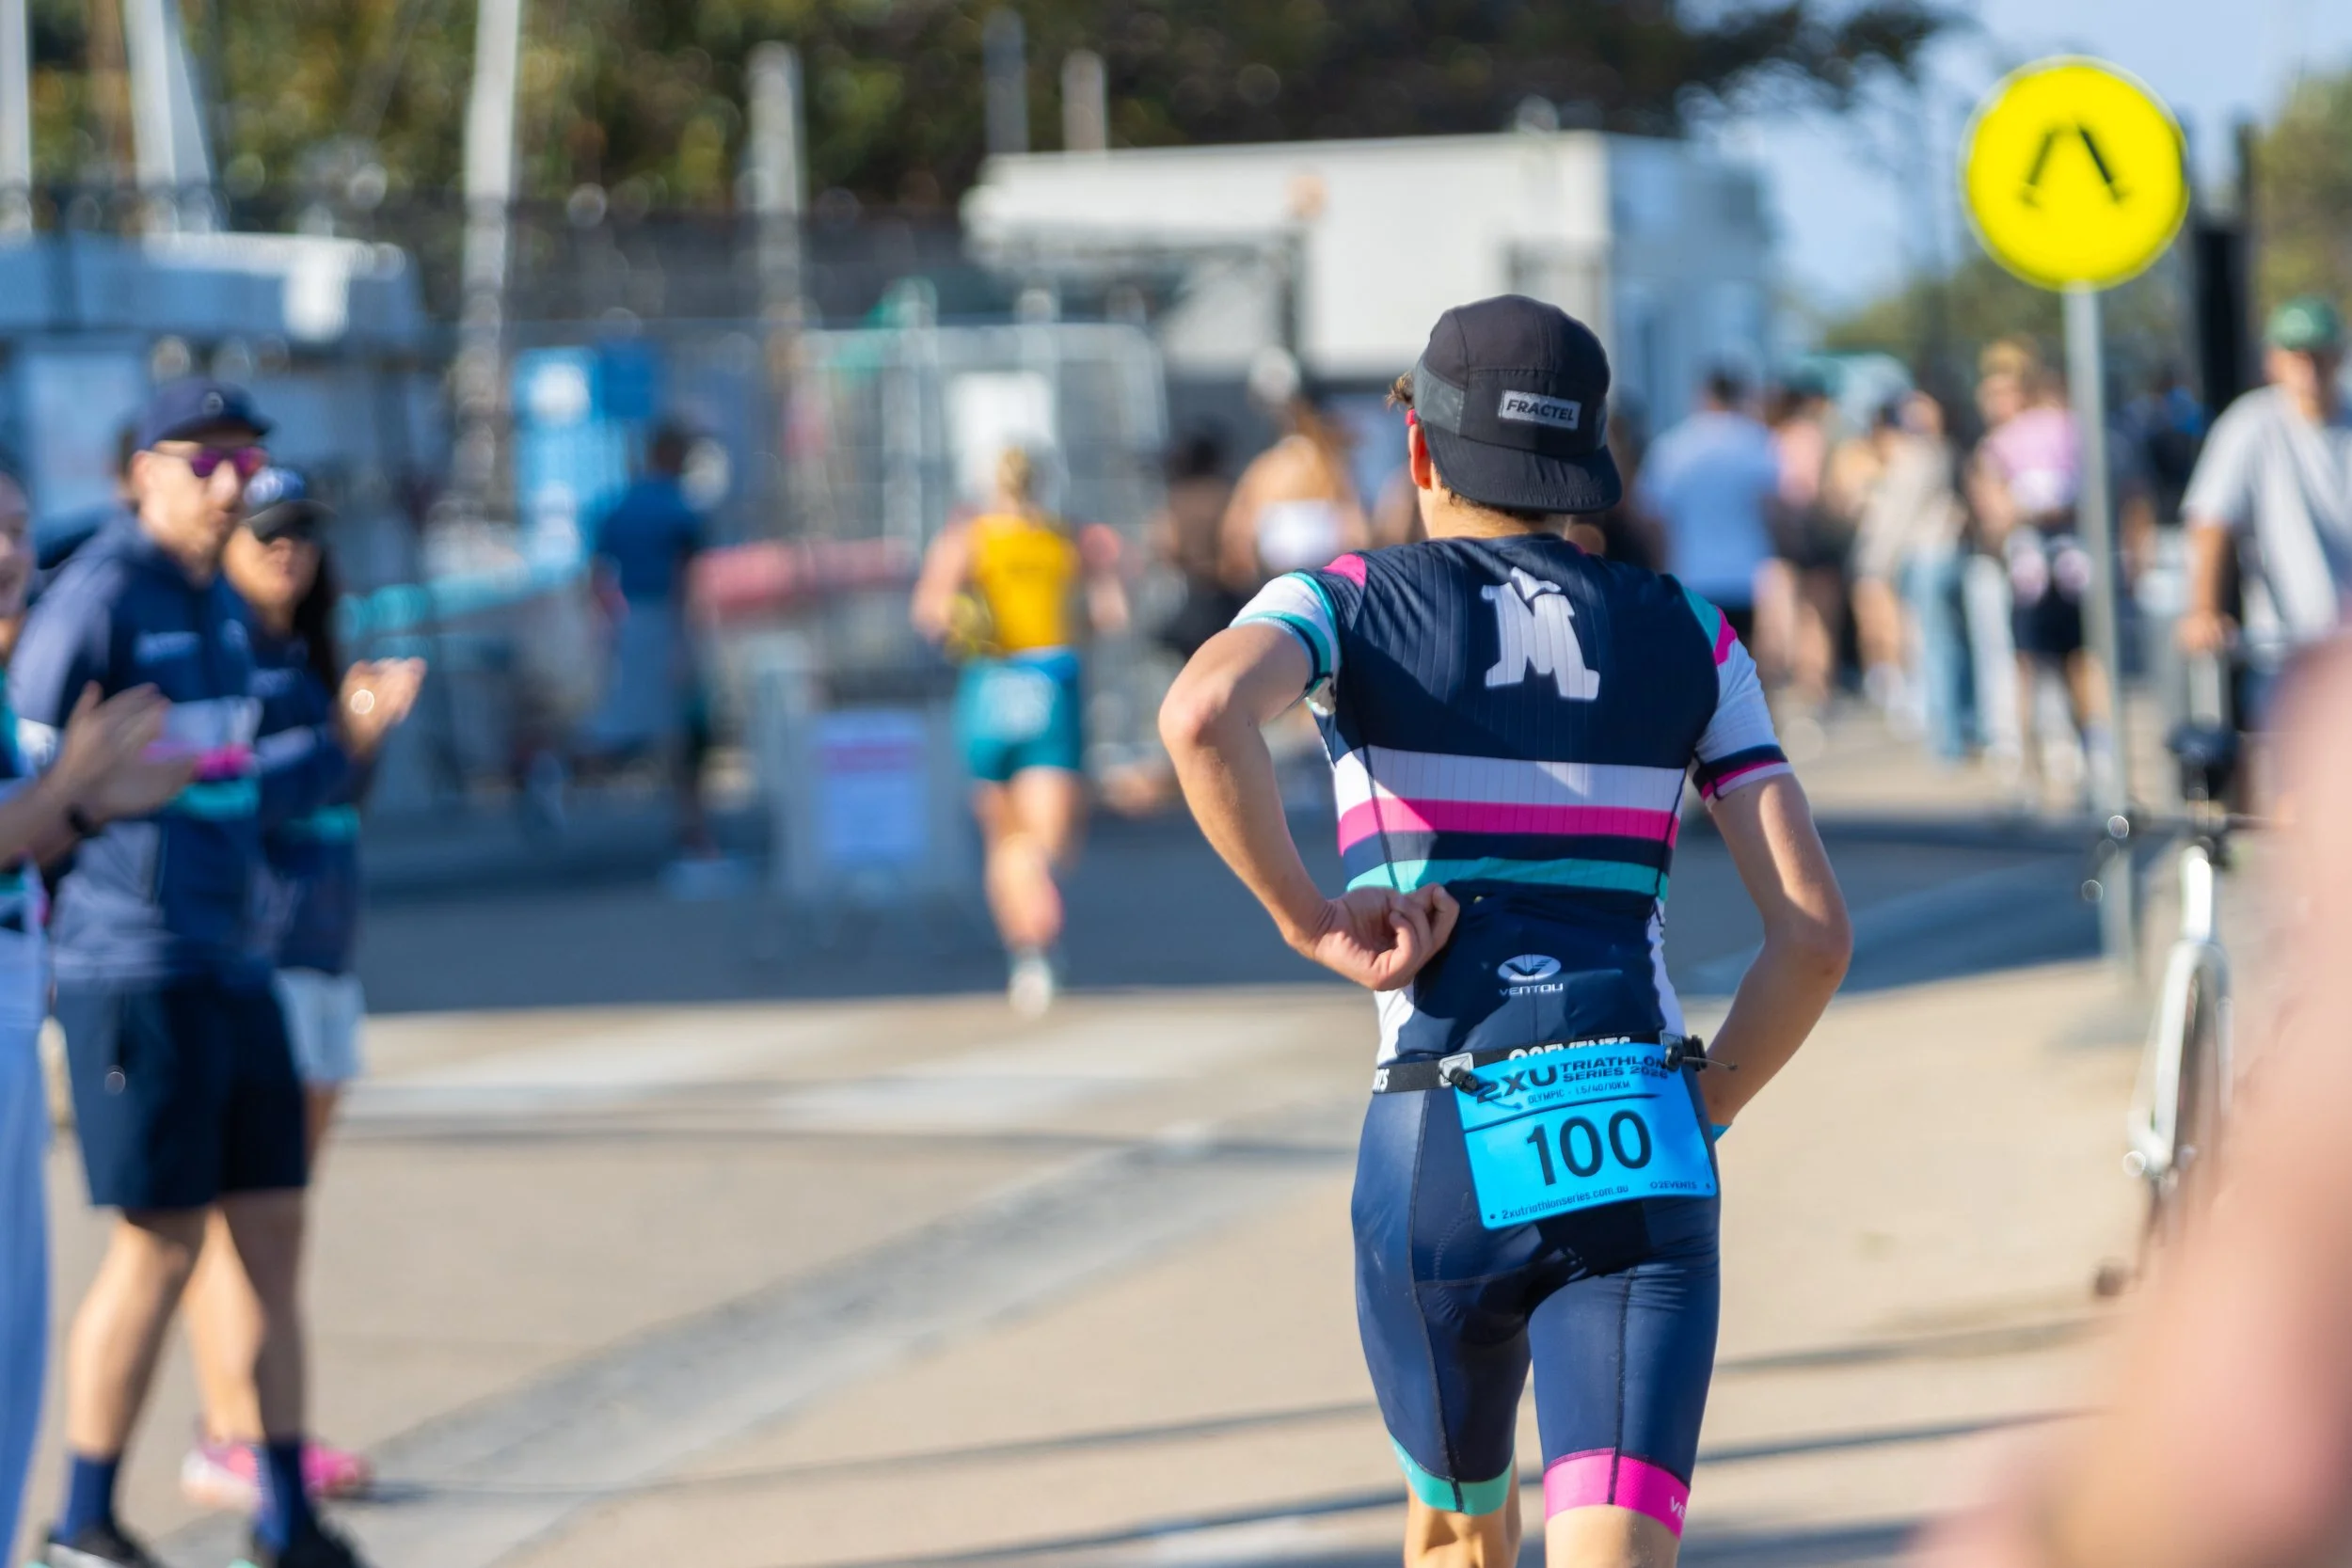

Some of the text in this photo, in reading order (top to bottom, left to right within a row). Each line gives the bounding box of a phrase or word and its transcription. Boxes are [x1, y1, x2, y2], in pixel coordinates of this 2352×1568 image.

[1506, 399, 1574, 421] FRACTEL
[1560, 1055, 1667, 1073] TRIATHLON
[1477, 1065, 1558, 1104] 2XU
[1563, 1068, 1624, 1083] SERIES
[1528, 1088, 1565, 1104] OLYMPIC
[1526, 1109, 1653, 1187] 100
[1502, 1184, 1629, 1220] 2xutriathlonseries.com.au
